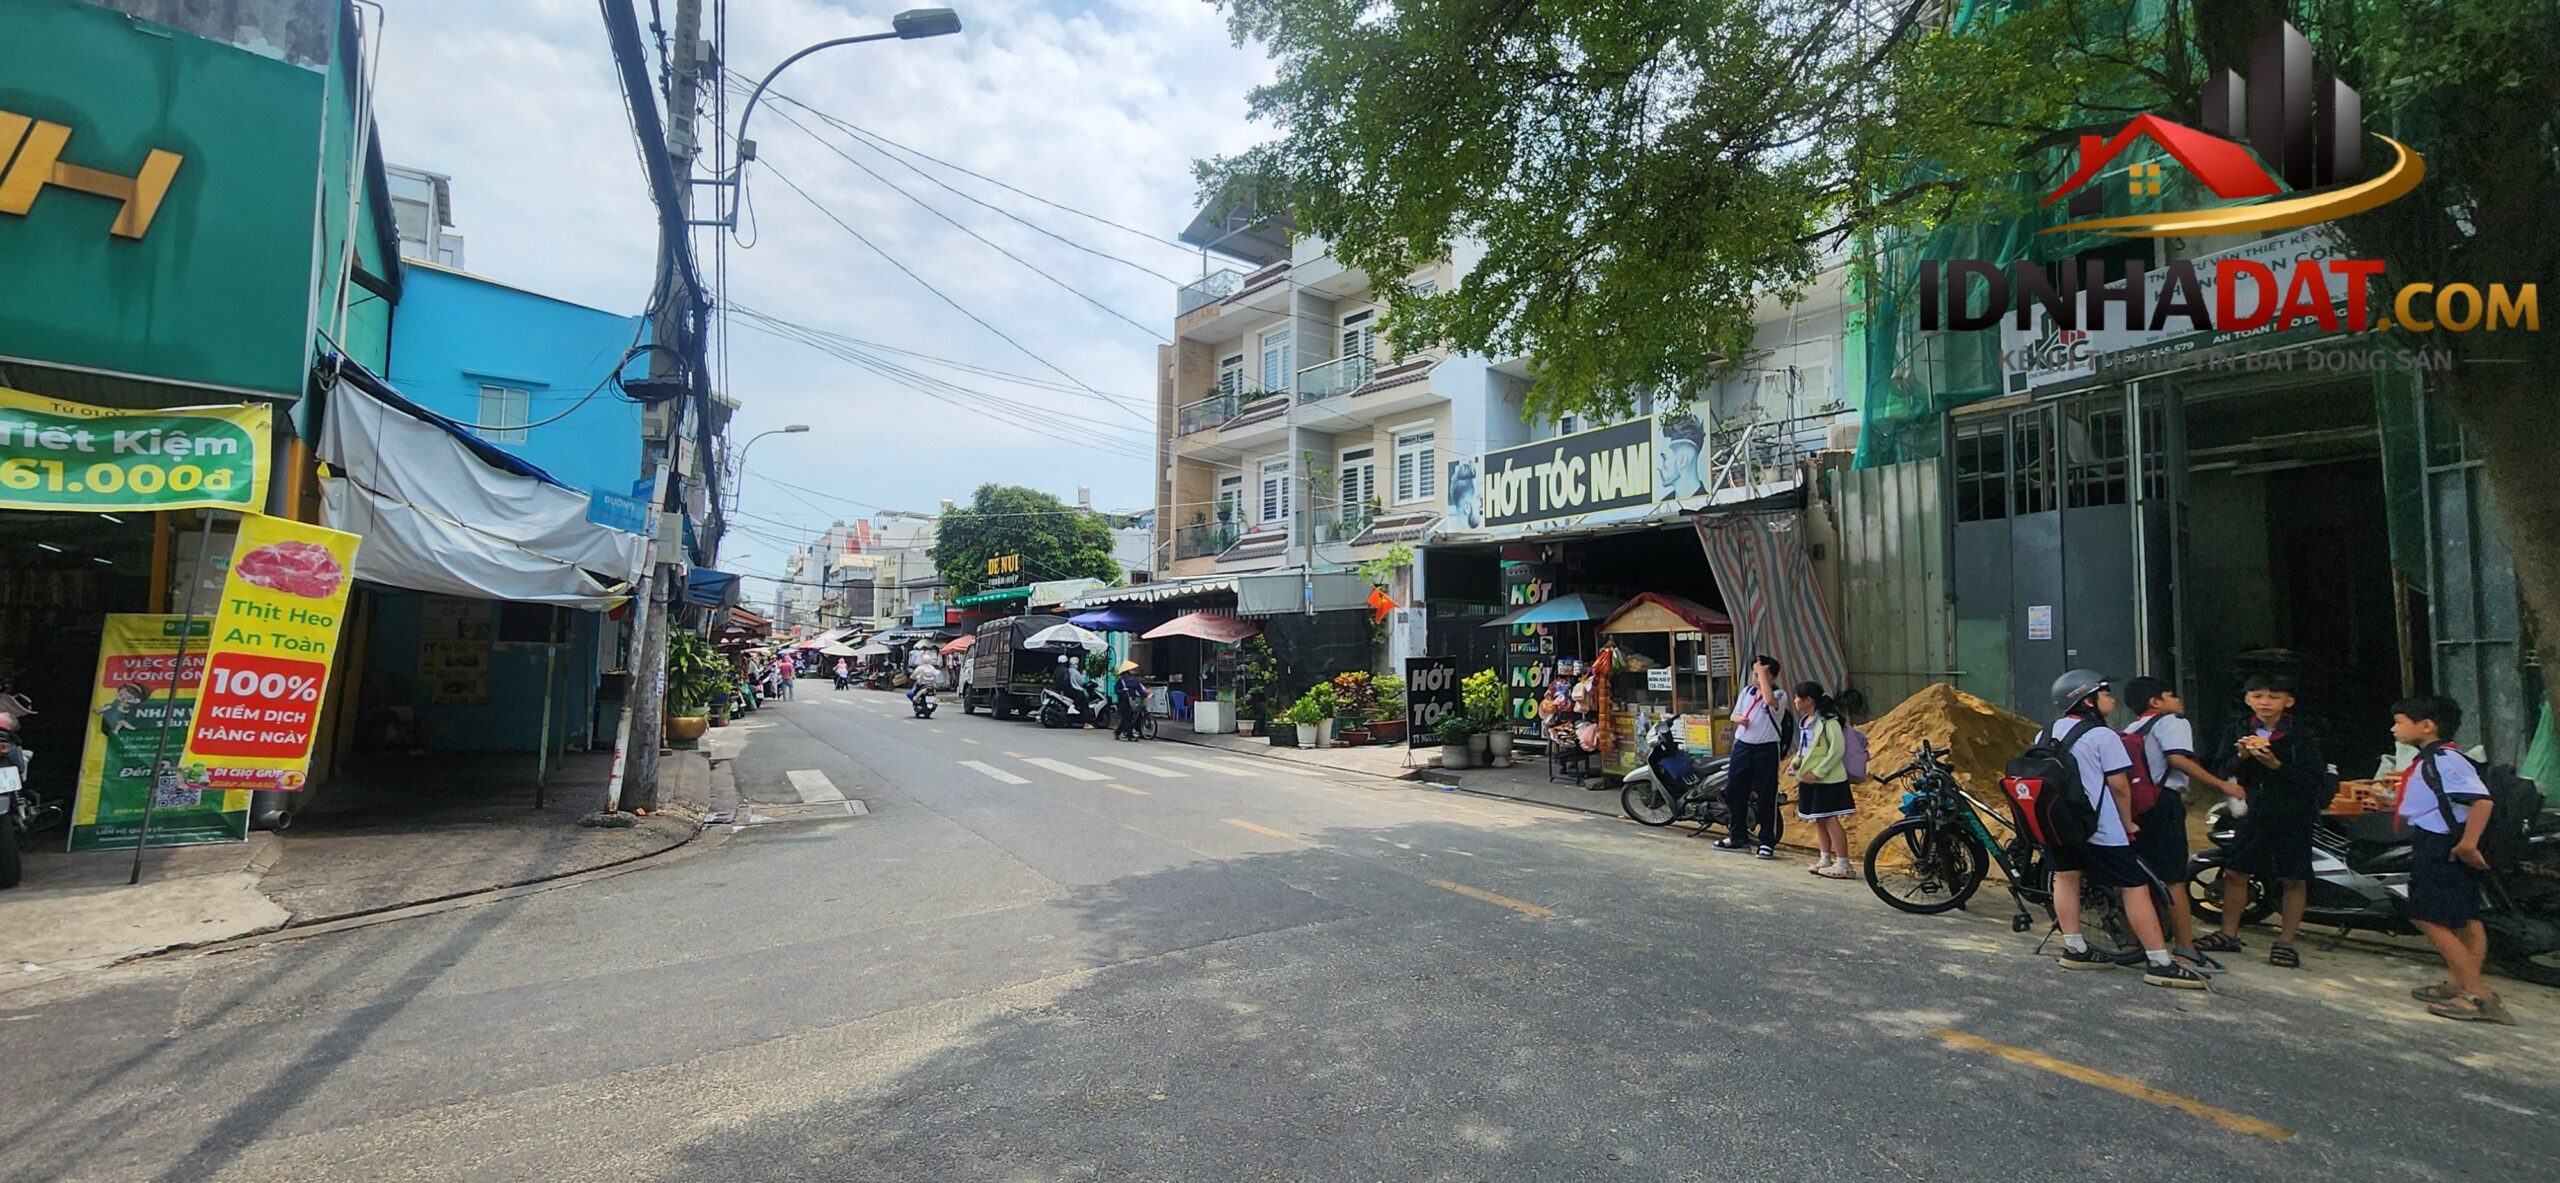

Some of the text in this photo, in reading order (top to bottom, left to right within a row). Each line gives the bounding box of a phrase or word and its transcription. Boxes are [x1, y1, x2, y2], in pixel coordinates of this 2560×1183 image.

[0, 420, 238, 463] Tiết Kiệm
[0, 457, 234, 494] 61.000đ
[1485, 441, 1650, 519] HỚT TÓC NAM
[1510, 577, 1552, 605] HỚT
[231, 599, 333, 628] Thịt Heo
[223, 628, 262, 646] An
[271, 632, 325, 654] Toàn
[212, 667, 318, 702] 100%
[1411, 661, 1455, 692] HỚT
[1512, 660, 1553, 688] HỚT
[210, 703, 261, 720] KIỂM
[264, 709, 306, 725] DỊCH
[197, 726, 308, 744] HÀNG NGÀY
